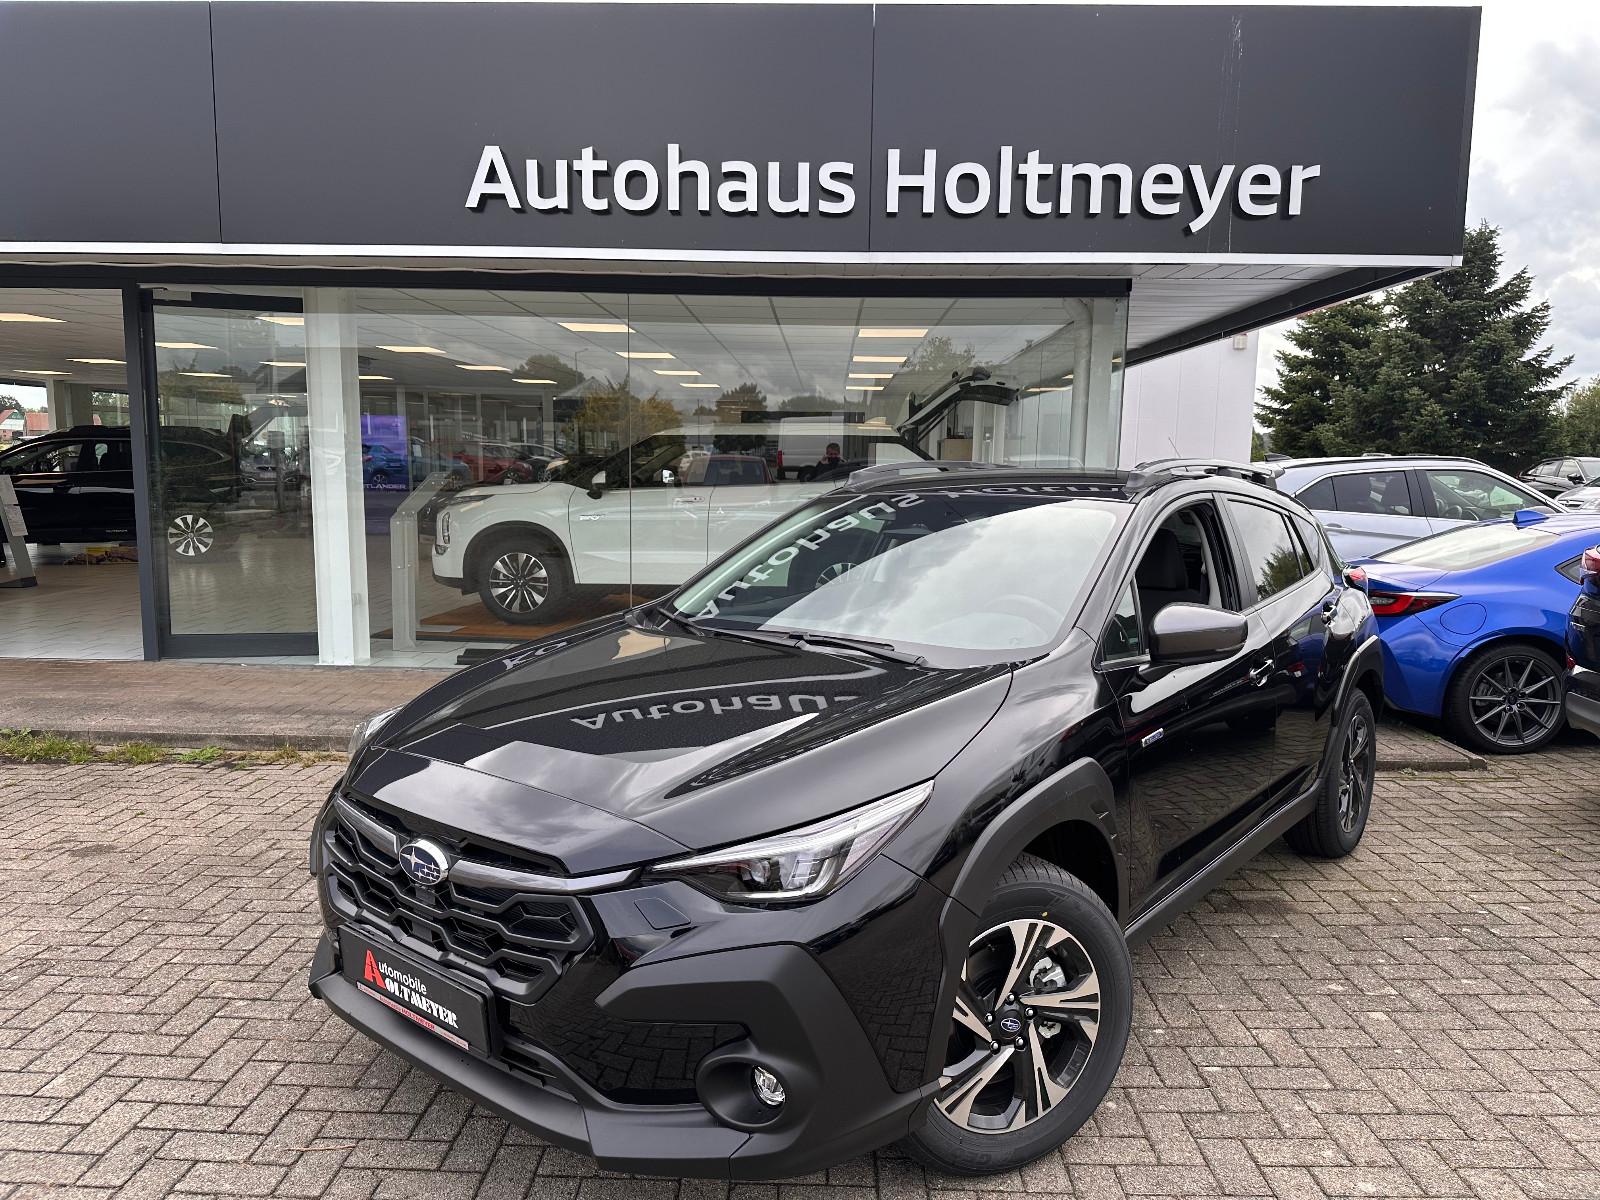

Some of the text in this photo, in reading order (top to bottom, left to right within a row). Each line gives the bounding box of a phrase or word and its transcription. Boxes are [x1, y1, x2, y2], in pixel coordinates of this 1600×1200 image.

[464, 143, 1321, 233] Autohaus Holtmeyer
[364, 949, 427, 995] Automobile
